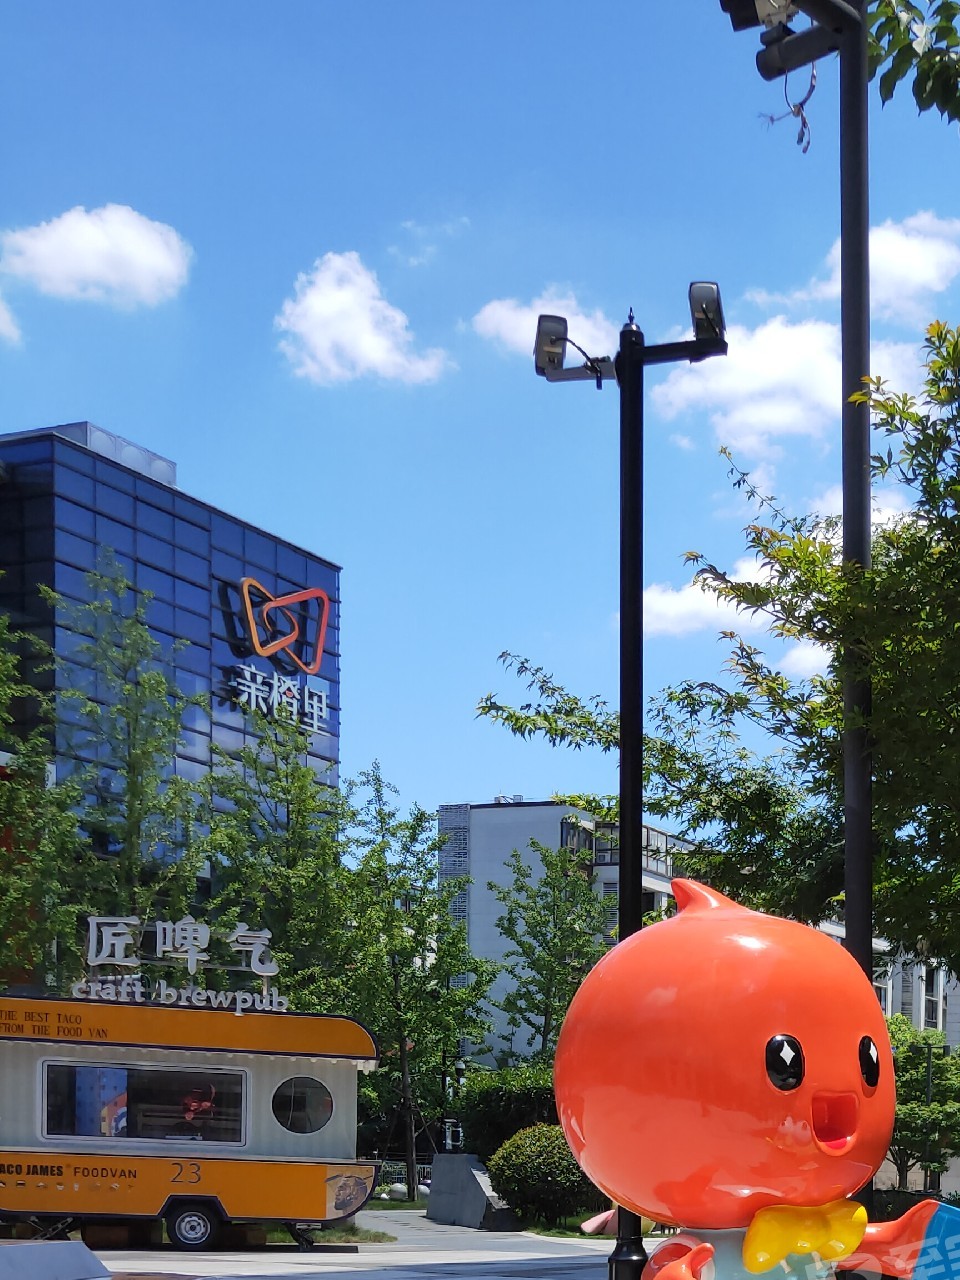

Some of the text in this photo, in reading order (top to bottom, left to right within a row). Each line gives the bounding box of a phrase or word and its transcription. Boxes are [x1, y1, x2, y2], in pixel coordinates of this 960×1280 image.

[229, 663, 331, 736] 亲橙里
[87, 914, 279, 976] 匠啤气
[72, 978, 289, 1016] craft brewpub
[24, 1011, 50, 1023] BEST
[57, 1013, 82, 1025] TACO
[32, 1024, 50, 1036] THE
[57, 1026, 83, 1038] FOOD
[88, 1028, 108, 1039] VAN
[25, 1164, 64, 1177] JAMES
[73, 1166, 137, 1179] FOODVAN
[170, 1162, 202, 1184] 23
